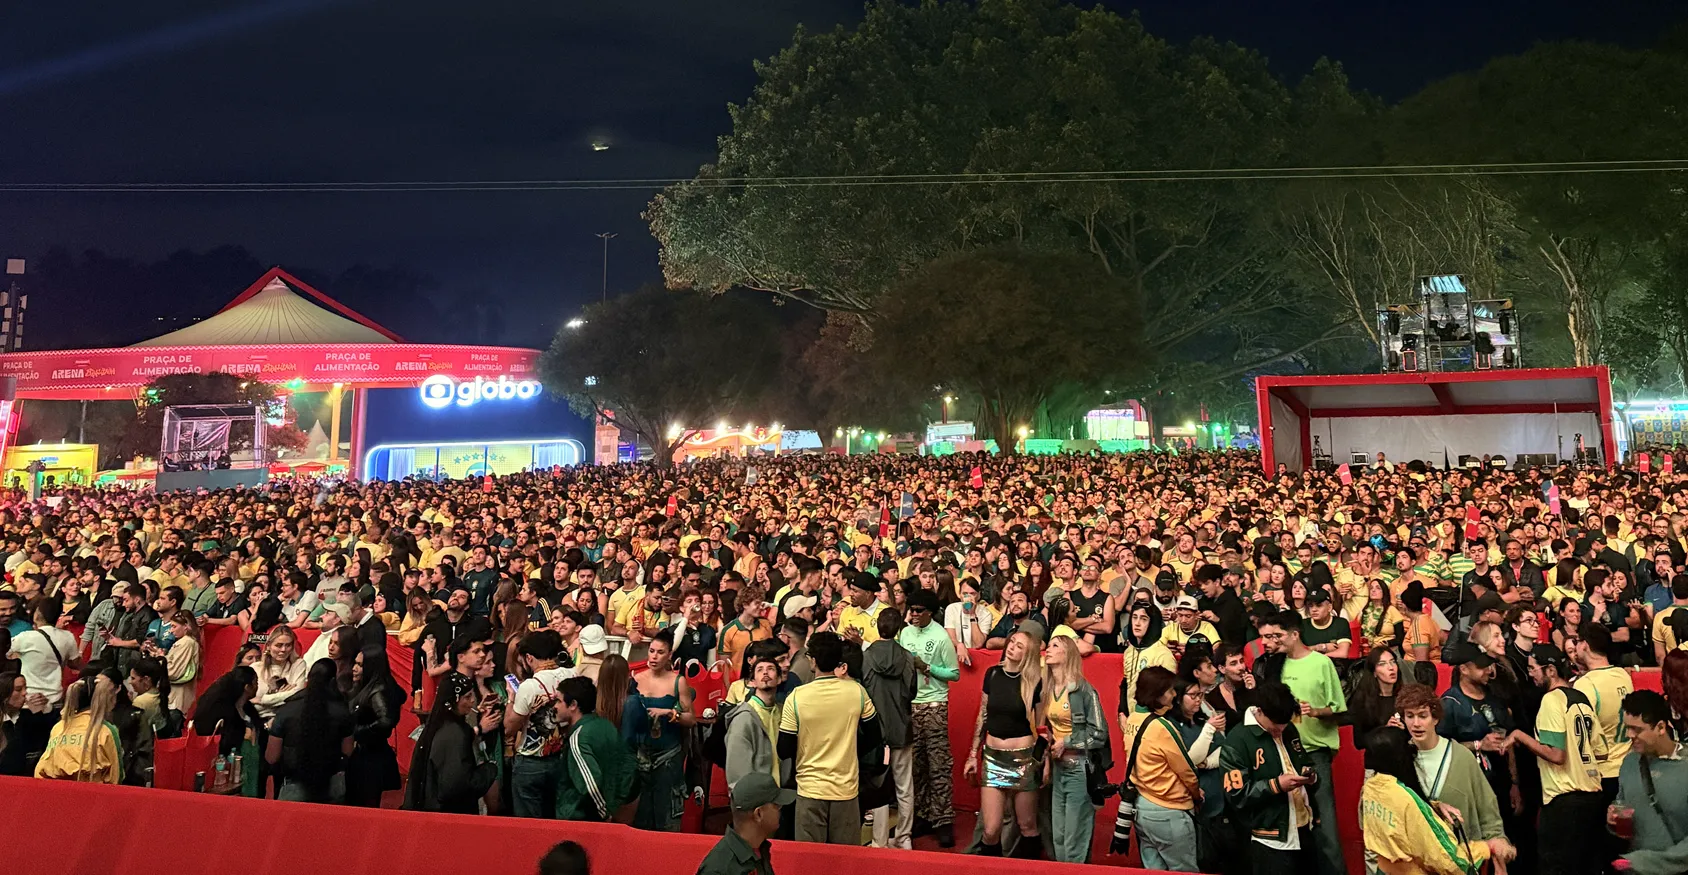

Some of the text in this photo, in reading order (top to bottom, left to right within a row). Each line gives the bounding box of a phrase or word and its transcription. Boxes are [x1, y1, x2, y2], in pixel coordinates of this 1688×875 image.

[143, 355, 192, 365] PRAÇA DE
[325, 352, 371, 362] PRAÇA DE
[471, 354, 490, 362] PRAÇA
[3, 361, 33, 371] PRAÇA DE
[132, 364, 202, 376] ALIMENTAÇÃO
[220, 363, 261, 374] ARENA
[314, 361, 380, 373] ALIMENTAÇÃO
[395, 361, 428, 371] ARENA
[463, 363, 503, 372] ALIMENTAÇÃO
[51, 369, 84, 380] ARENA
[456, 374, 536, 406] globo
[1223, 768, 1244, 793] 49
